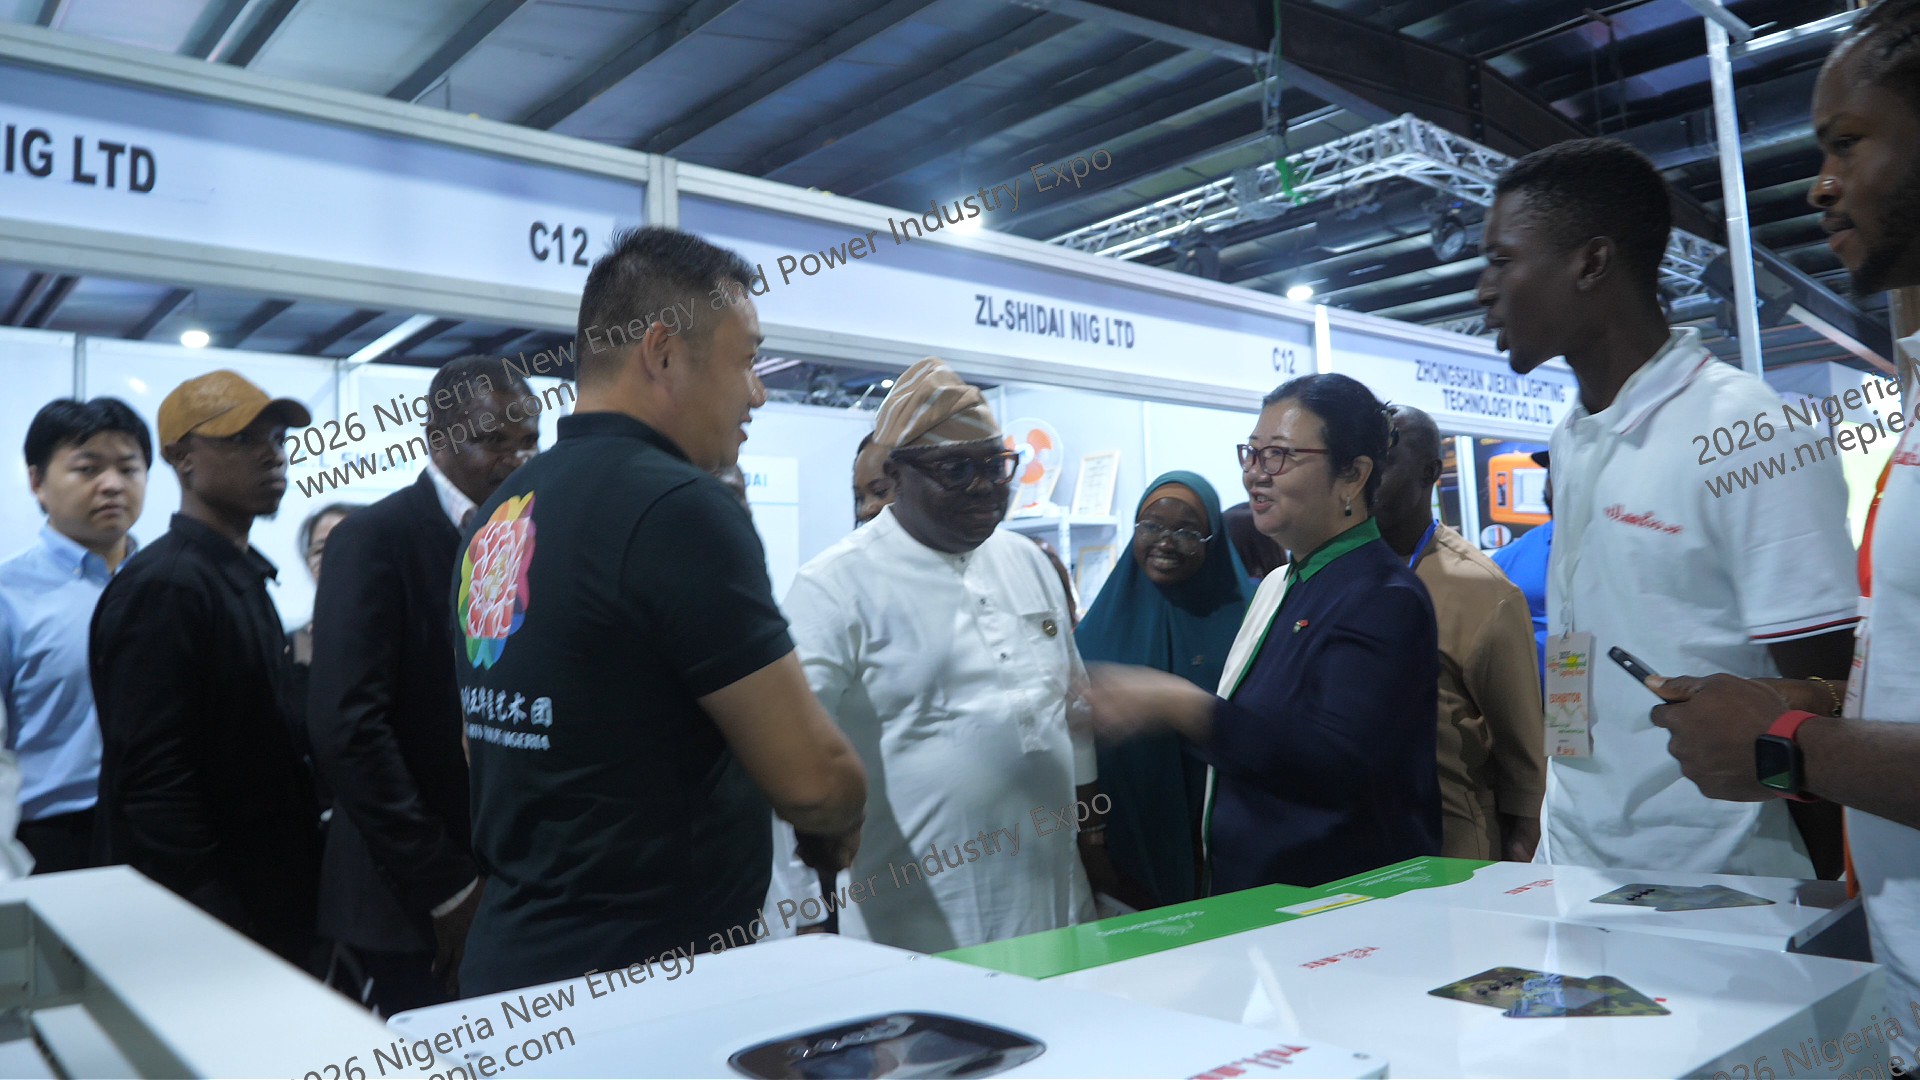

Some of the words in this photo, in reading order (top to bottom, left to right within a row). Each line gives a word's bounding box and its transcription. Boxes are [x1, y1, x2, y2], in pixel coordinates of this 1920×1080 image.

[73, 135, 157, 193] LTD
[529, 220, 589, 267] C12
[974, 294, 1065, 338] ZL-SHIDAI
[1070, 311, 1100, 345] NIG
[1106, 317, 1136, 349] LTD
[1272, 347, 1296, 375] C12
[1415, 359, 1485, 392] ZHONGSHAN
[1520, 376, 1566, 403] LIGHTING
[1442, 388, 1513, 419] TECHNOLOGY
